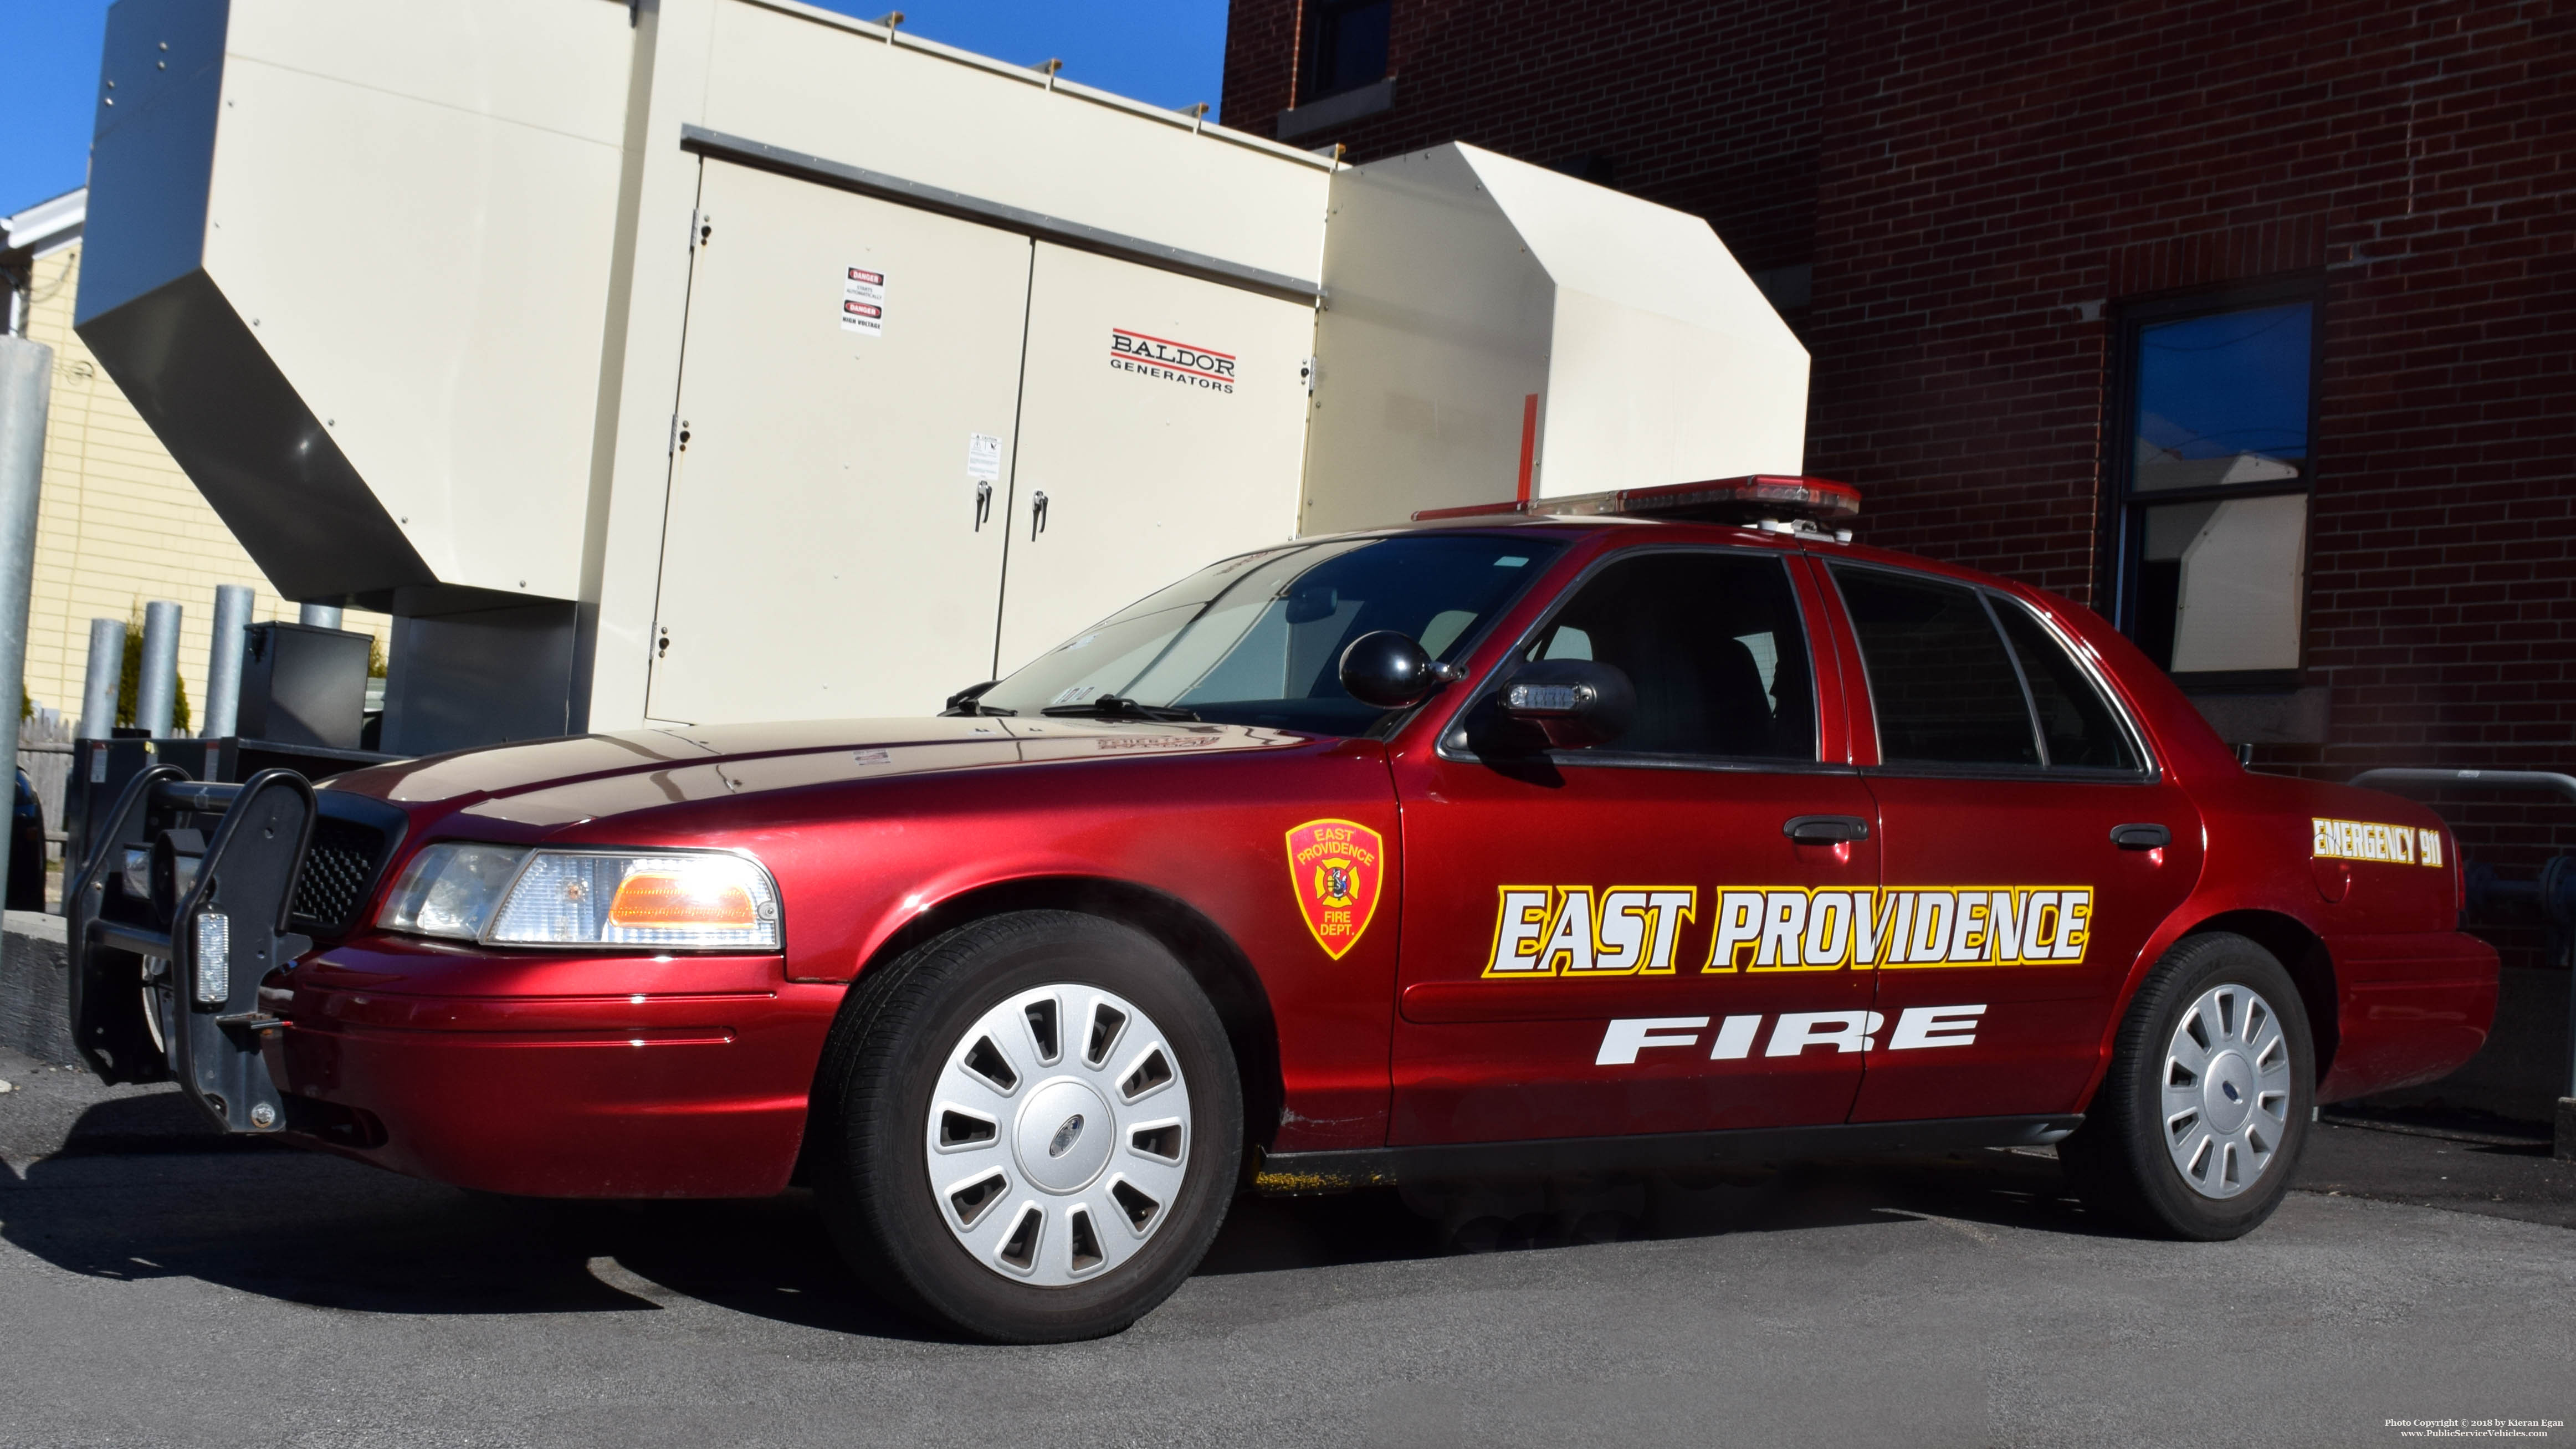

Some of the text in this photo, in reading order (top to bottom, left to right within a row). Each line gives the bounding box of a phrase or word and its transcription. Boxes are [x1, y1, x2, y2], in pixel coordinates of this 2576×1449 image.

[853, 270, 879, 283] DANGER
[849, 304, 876, 315] DANGER
[858, 320, 880, 329] VOLTAGE
[1111, 334, 1235, 377] BALDOR
[1110, 359, 1233, 394] GENERATORS
[1314, 828, 1354, 842] EAST
[2312, 817, 2443, 867] EMERGENCY 911
[1297, 842, 1375, 866] PROVIDENCE
[1324, 911, 1351, 923] FIRE
[1320, 924, 1355, 935] DEPT.
[1482, 885, 2093, 978] EAST PROVIDENCE
[1595, 1004, 1987, 1065] FIRE
